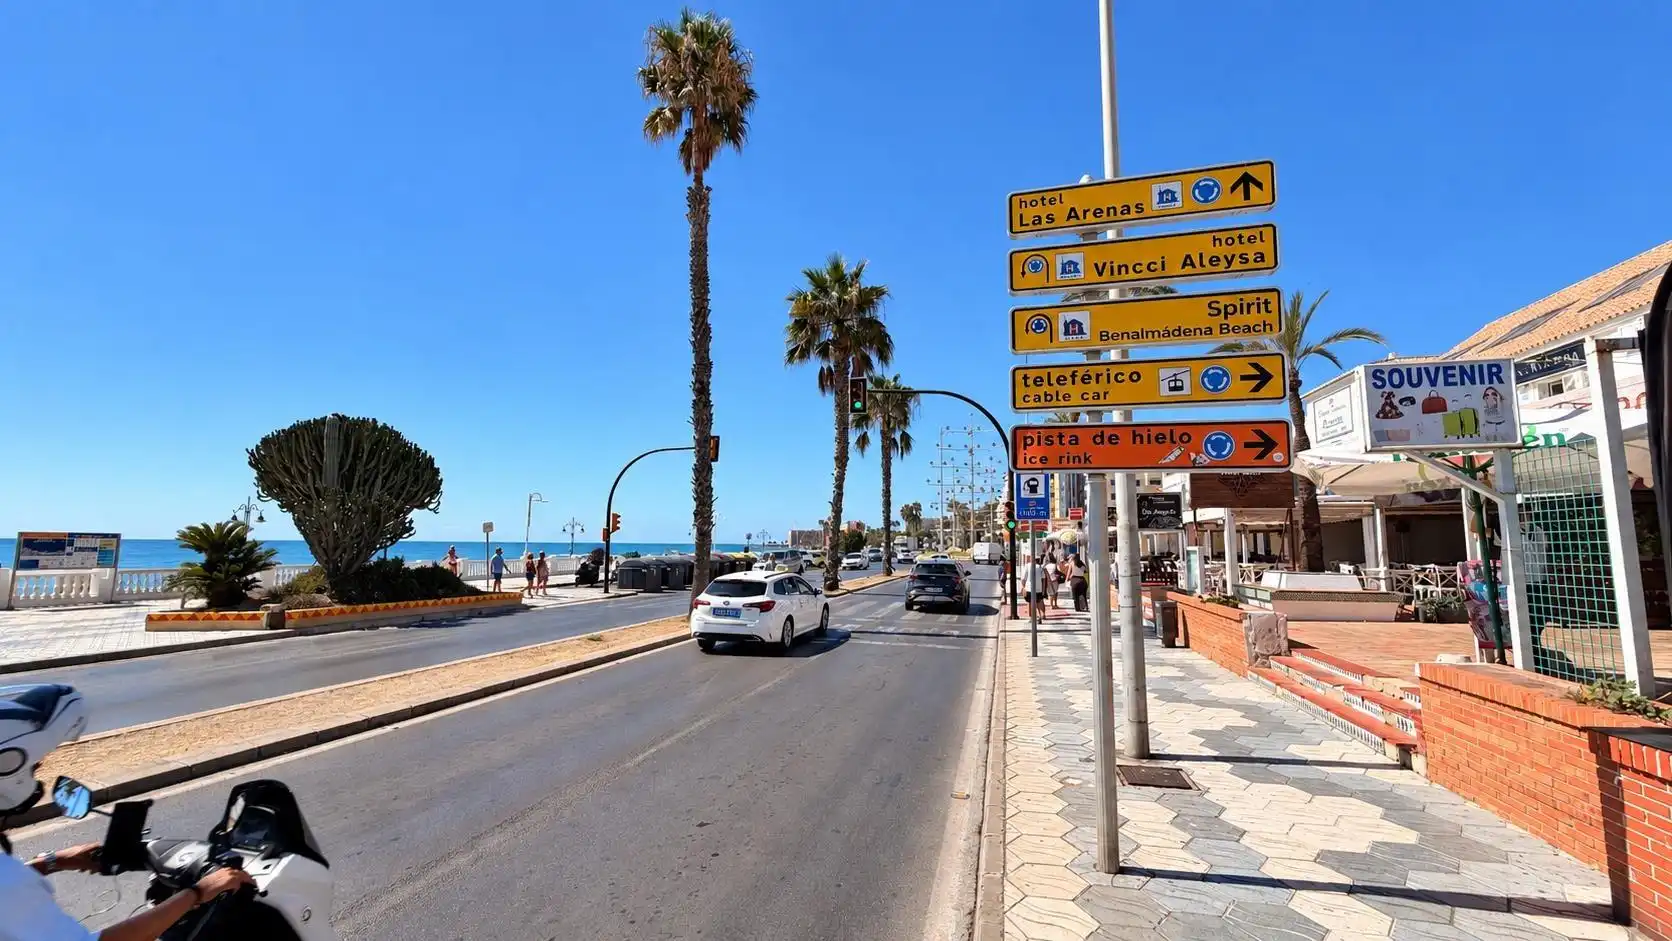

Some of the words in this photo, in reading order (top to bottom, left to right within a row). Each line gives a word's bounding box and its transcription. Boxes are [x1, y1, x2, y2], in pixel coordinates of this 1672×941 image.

[1019, 193, 1064, 209] hotel
[1019, 211, 1056, 228] Las
[1065, 200, 1145, 222] Arenas
[1212, 231, 1266, 248] hotel
[1093, 255, 1167, 277] Vincci
[1181, 249, 1266, 271] Aleysa
[1207, 297, 1273, 320] Spirit
[1099, 322, 1213, 343] Benalmádena
[1219, 319, 1274, 336] Beach
[1022, 368, 1142, 389] teleférico
[1371, 363, 1505, 390] SOUVENIR
[1022, 389, 1072, 403] cable
[1080, 389, 1110, 402] car
[1022, 431, 1080, 450] pista
[1092, 430, 1121, 446] de
[1131, 429, 1193, 446] hielo
[1023, 452, 1049, 465] ice
[1058, 452, 1093, 465] rink
